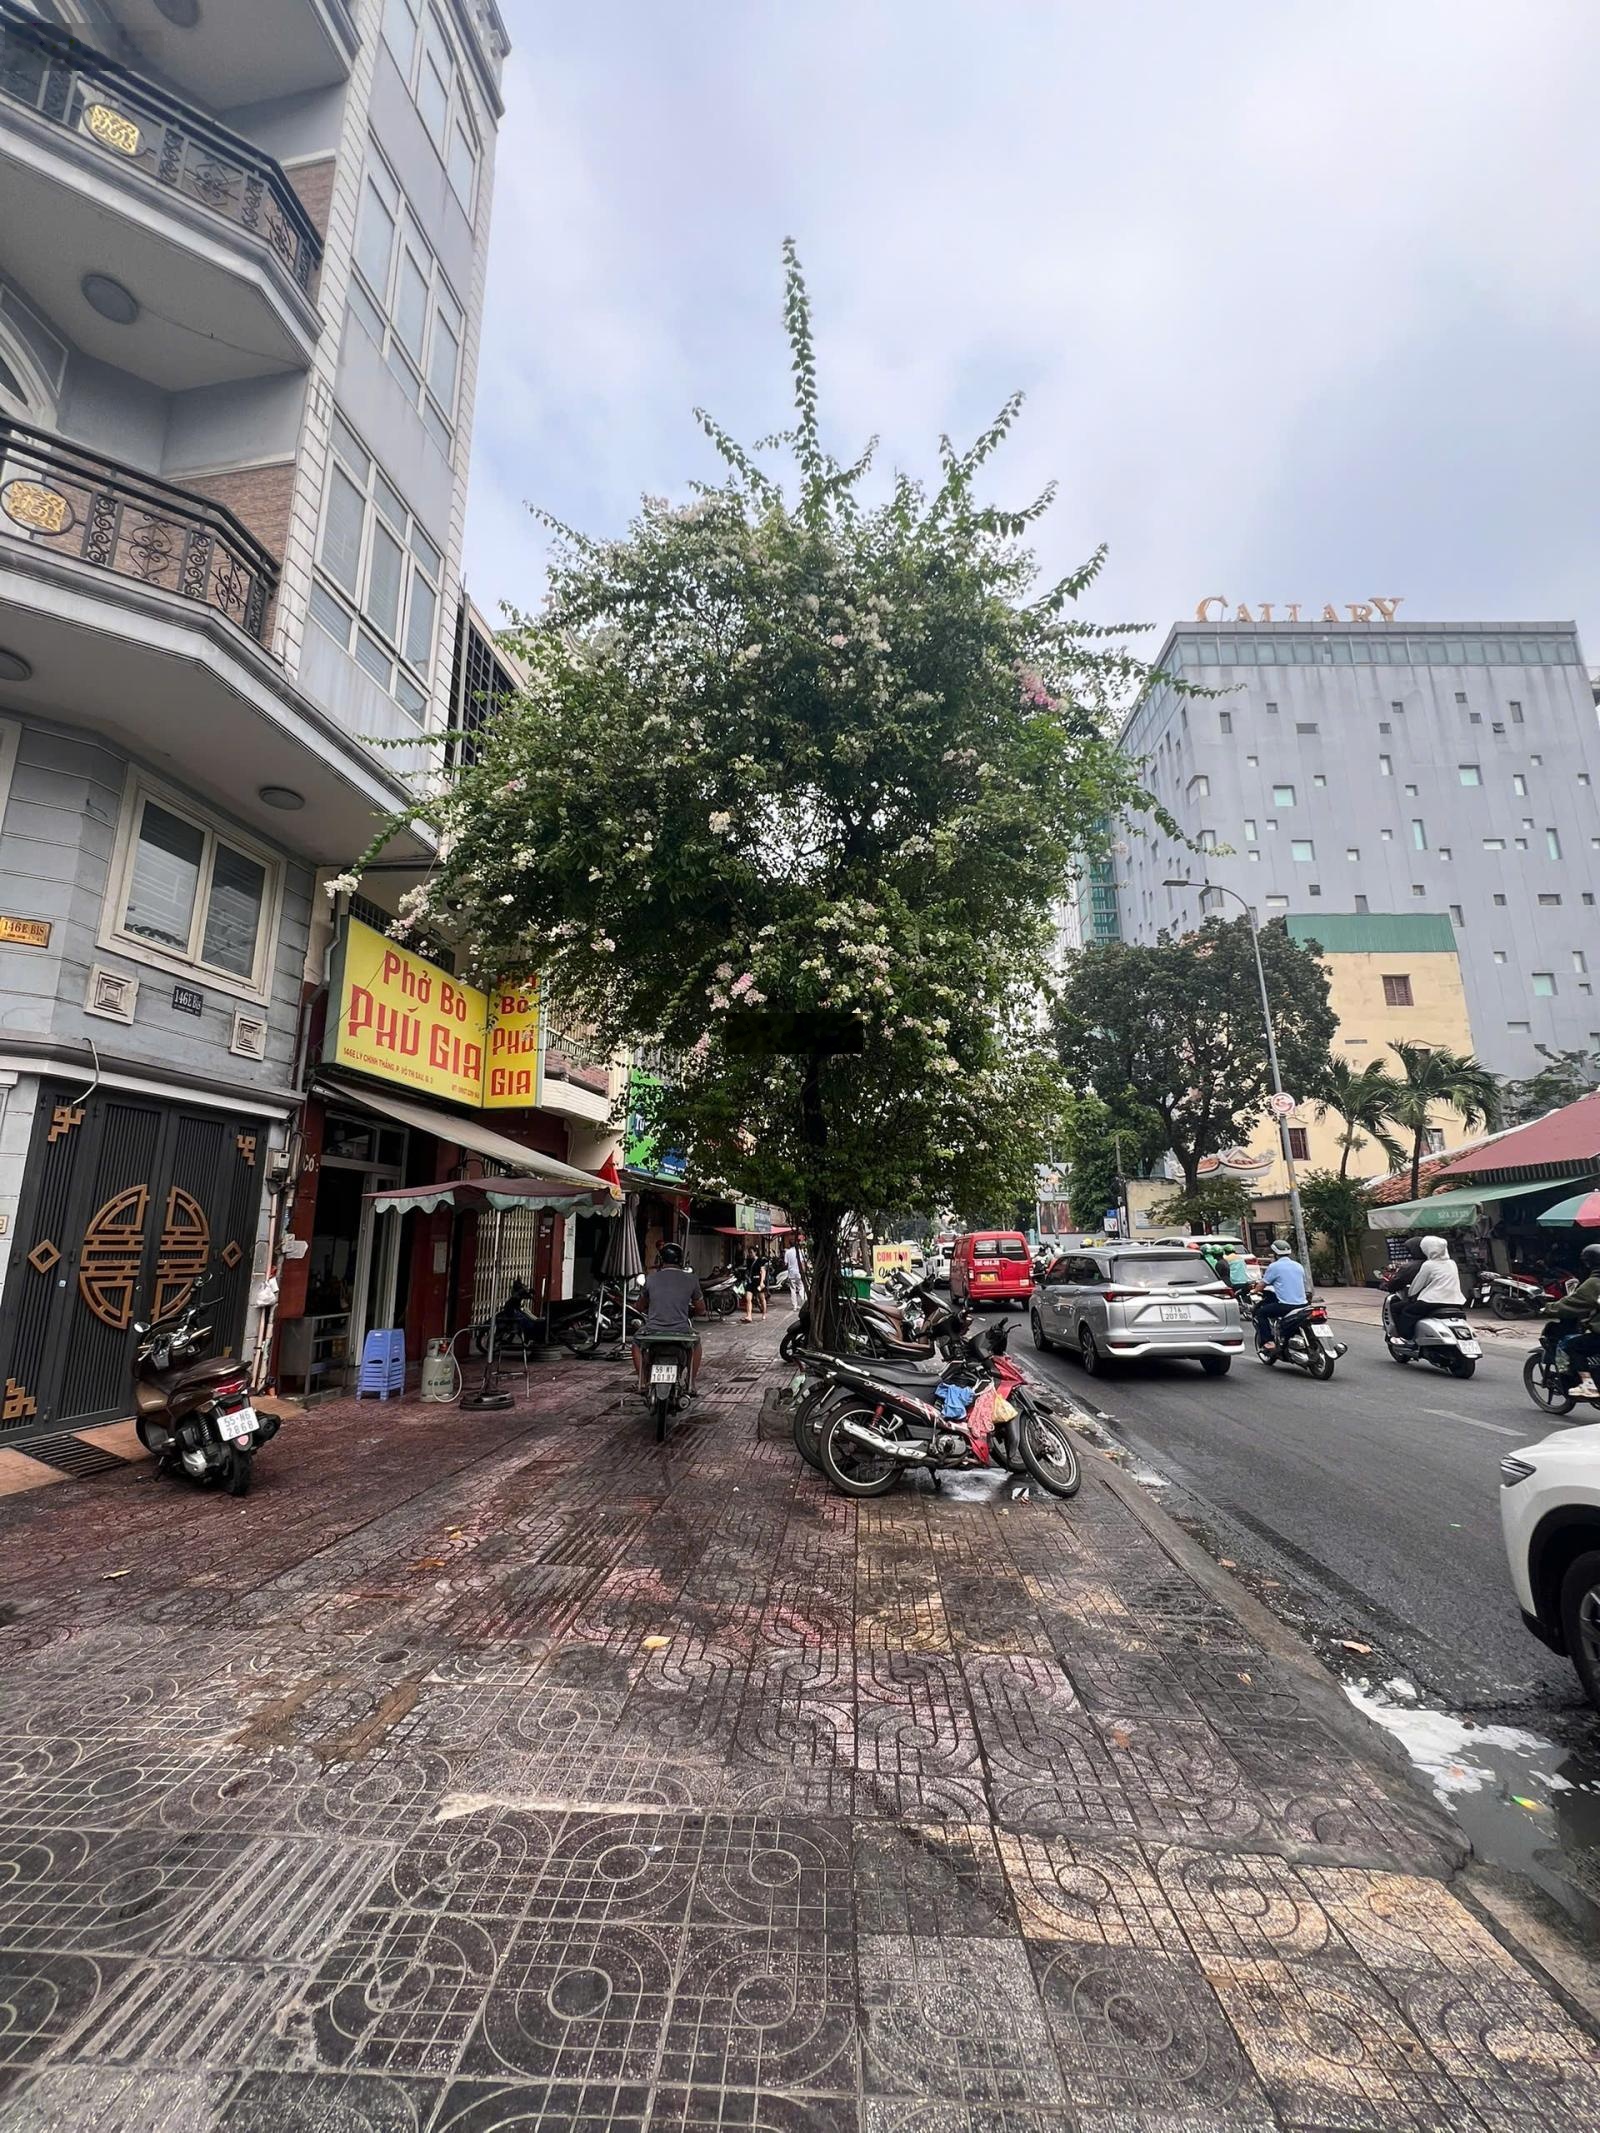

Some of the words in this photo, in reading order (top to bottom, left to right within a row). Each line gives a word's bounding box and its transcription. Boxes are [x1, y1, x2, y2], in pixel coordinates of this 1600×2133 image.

[4, 921, 28, 933] 146E
[383, 950, 431, 1004] Phở
[440, 981, 467, 1023] Bò
[174, 989, 193, 1007] 146E
[501, 996, 529, 1014] Bò
[349, 984, 421, 1056] PHÚ
[429, 1023, 482, 1082] GIA
[491, 1068, 531, 1097] GIA
[226, 1420, 254, 1437] 2868
